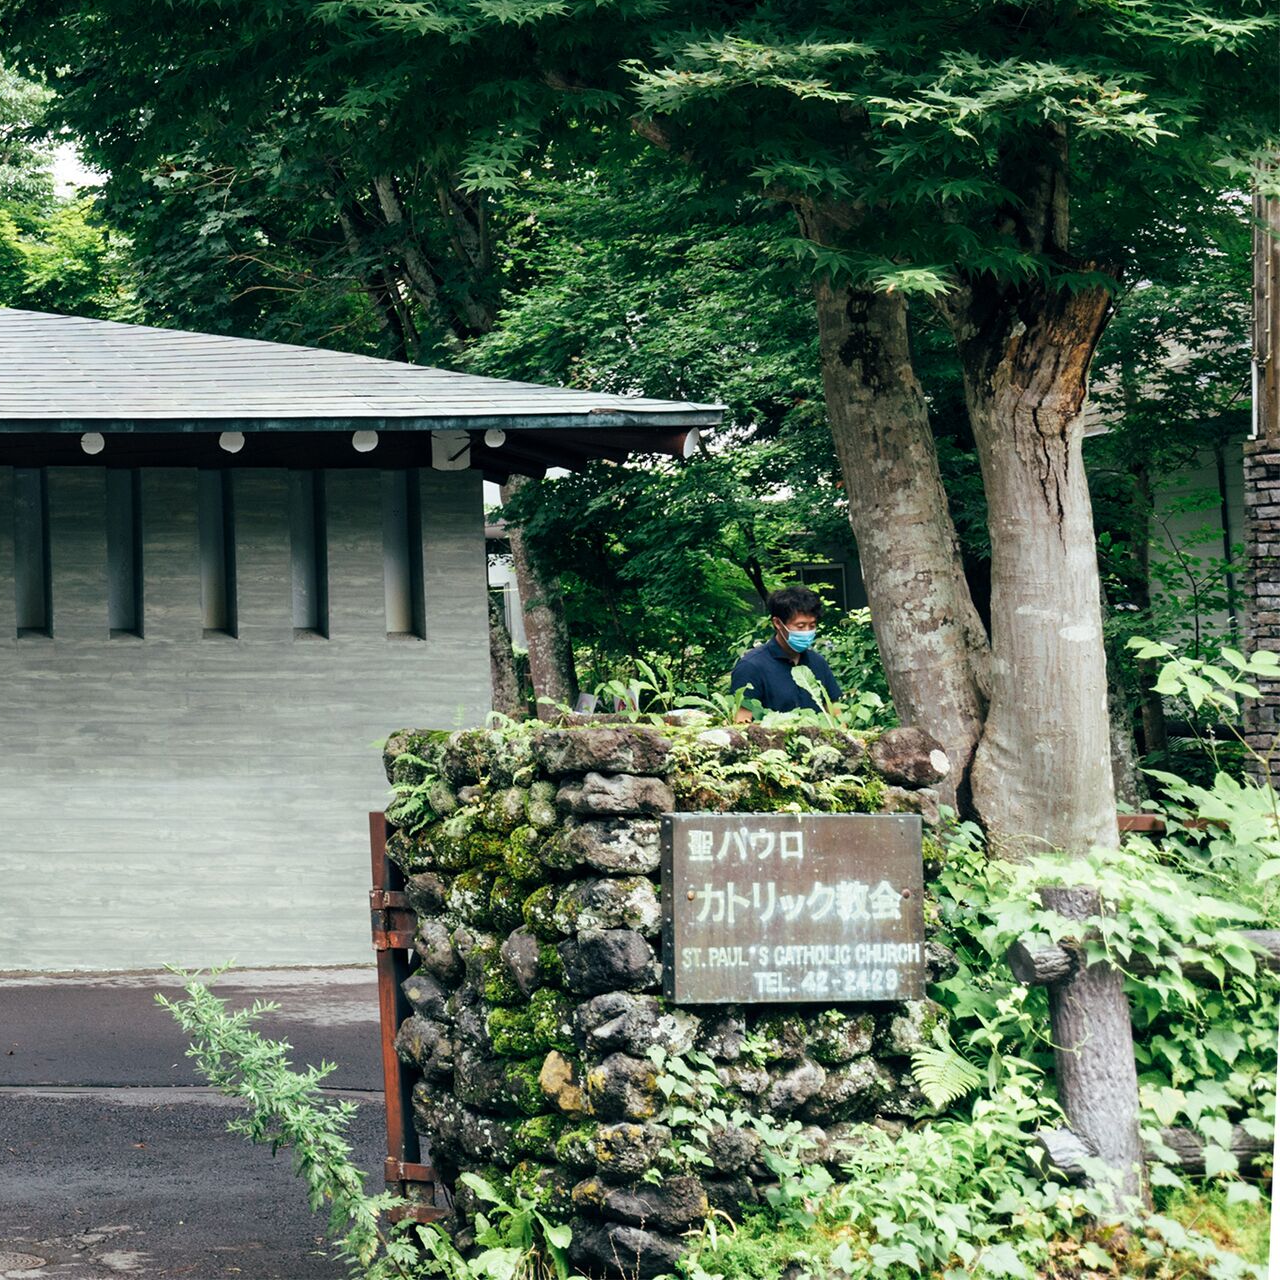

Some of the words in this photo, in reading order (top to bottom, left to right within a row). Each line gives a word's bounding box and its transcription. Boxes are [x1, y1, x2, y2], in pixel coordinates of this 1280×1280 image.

[687, 828, 804, 861] 聖パウロ
[695, 880, 903, 923] カトリック教会
[774, 944, 851, 966] CATHOLIC
[855, 943, 920, 964] CHURCH
